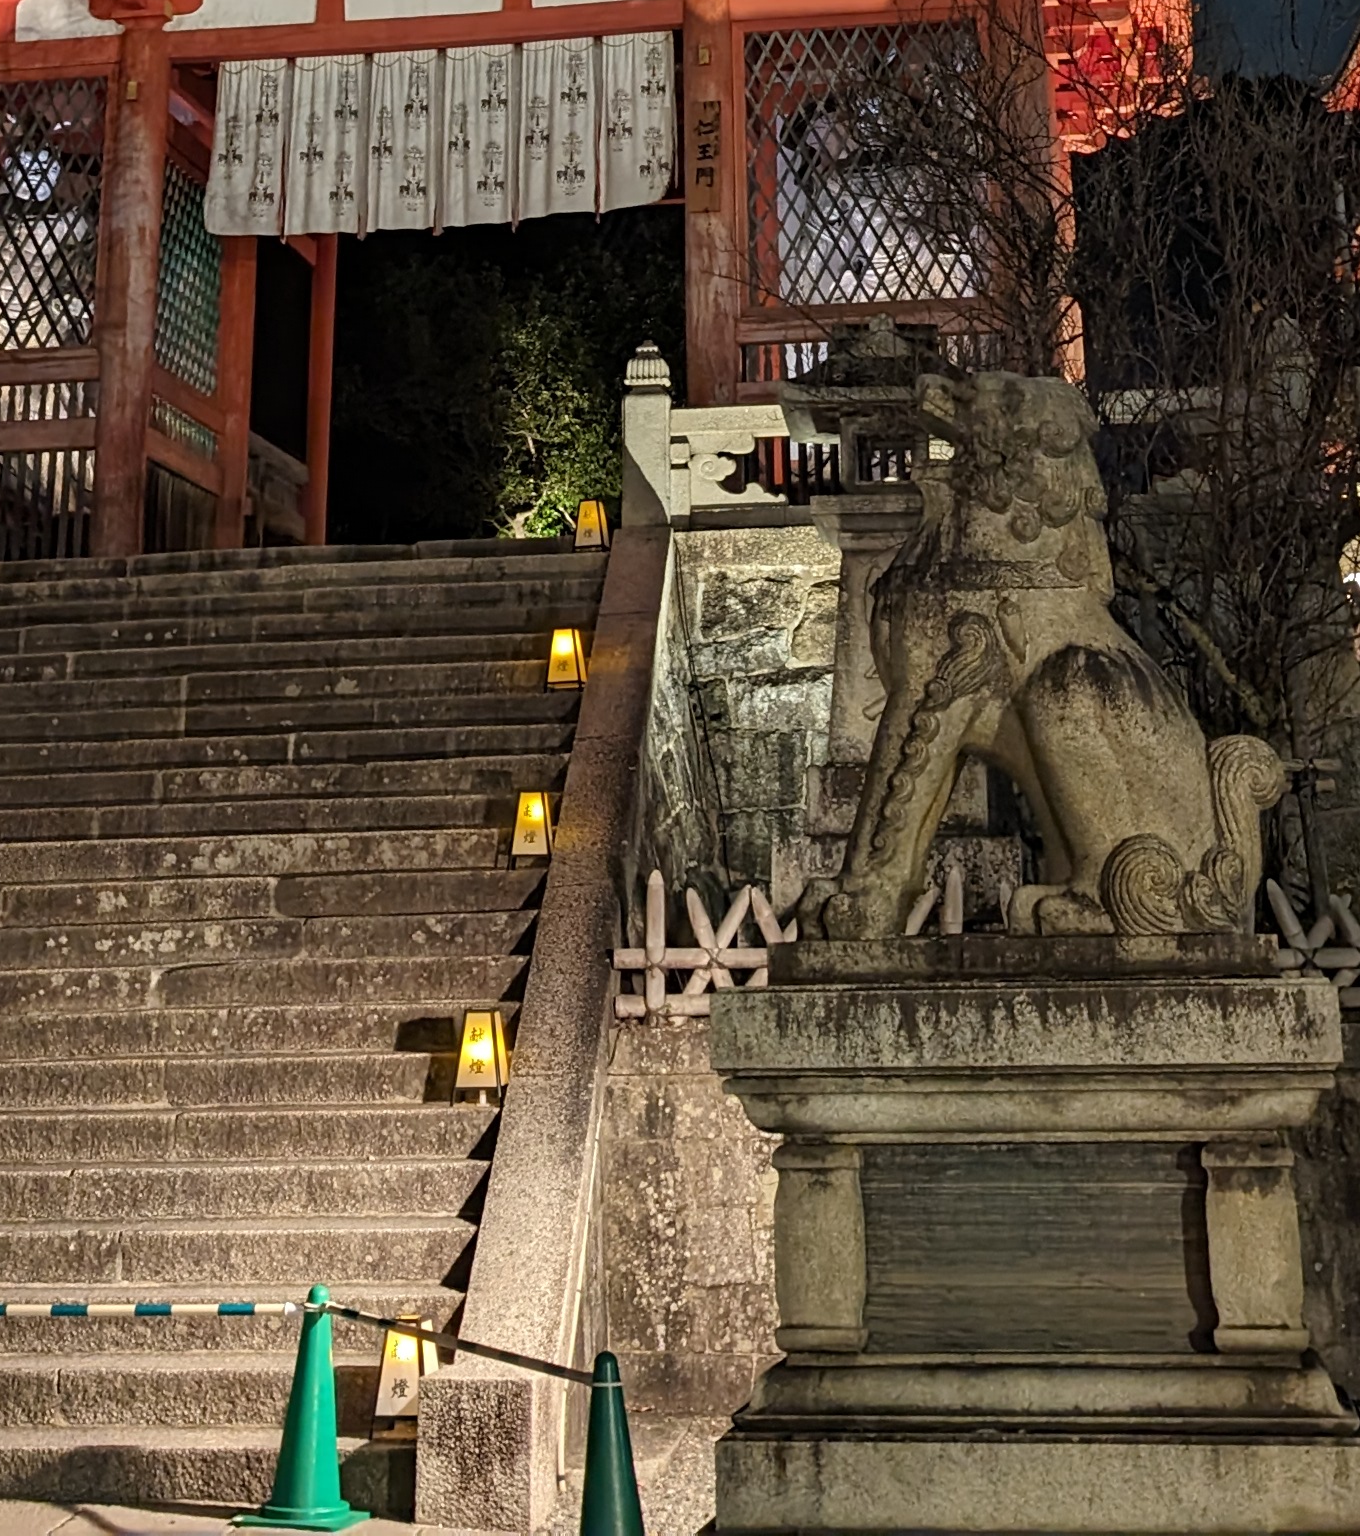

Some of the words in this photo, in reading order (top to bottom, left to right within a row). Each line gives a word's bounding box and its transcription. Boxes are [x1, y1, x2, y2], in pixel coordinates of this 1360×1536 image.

[693, 119, 715, 187] 仁王門
[469, 1027, 485, 1074] 献燈
